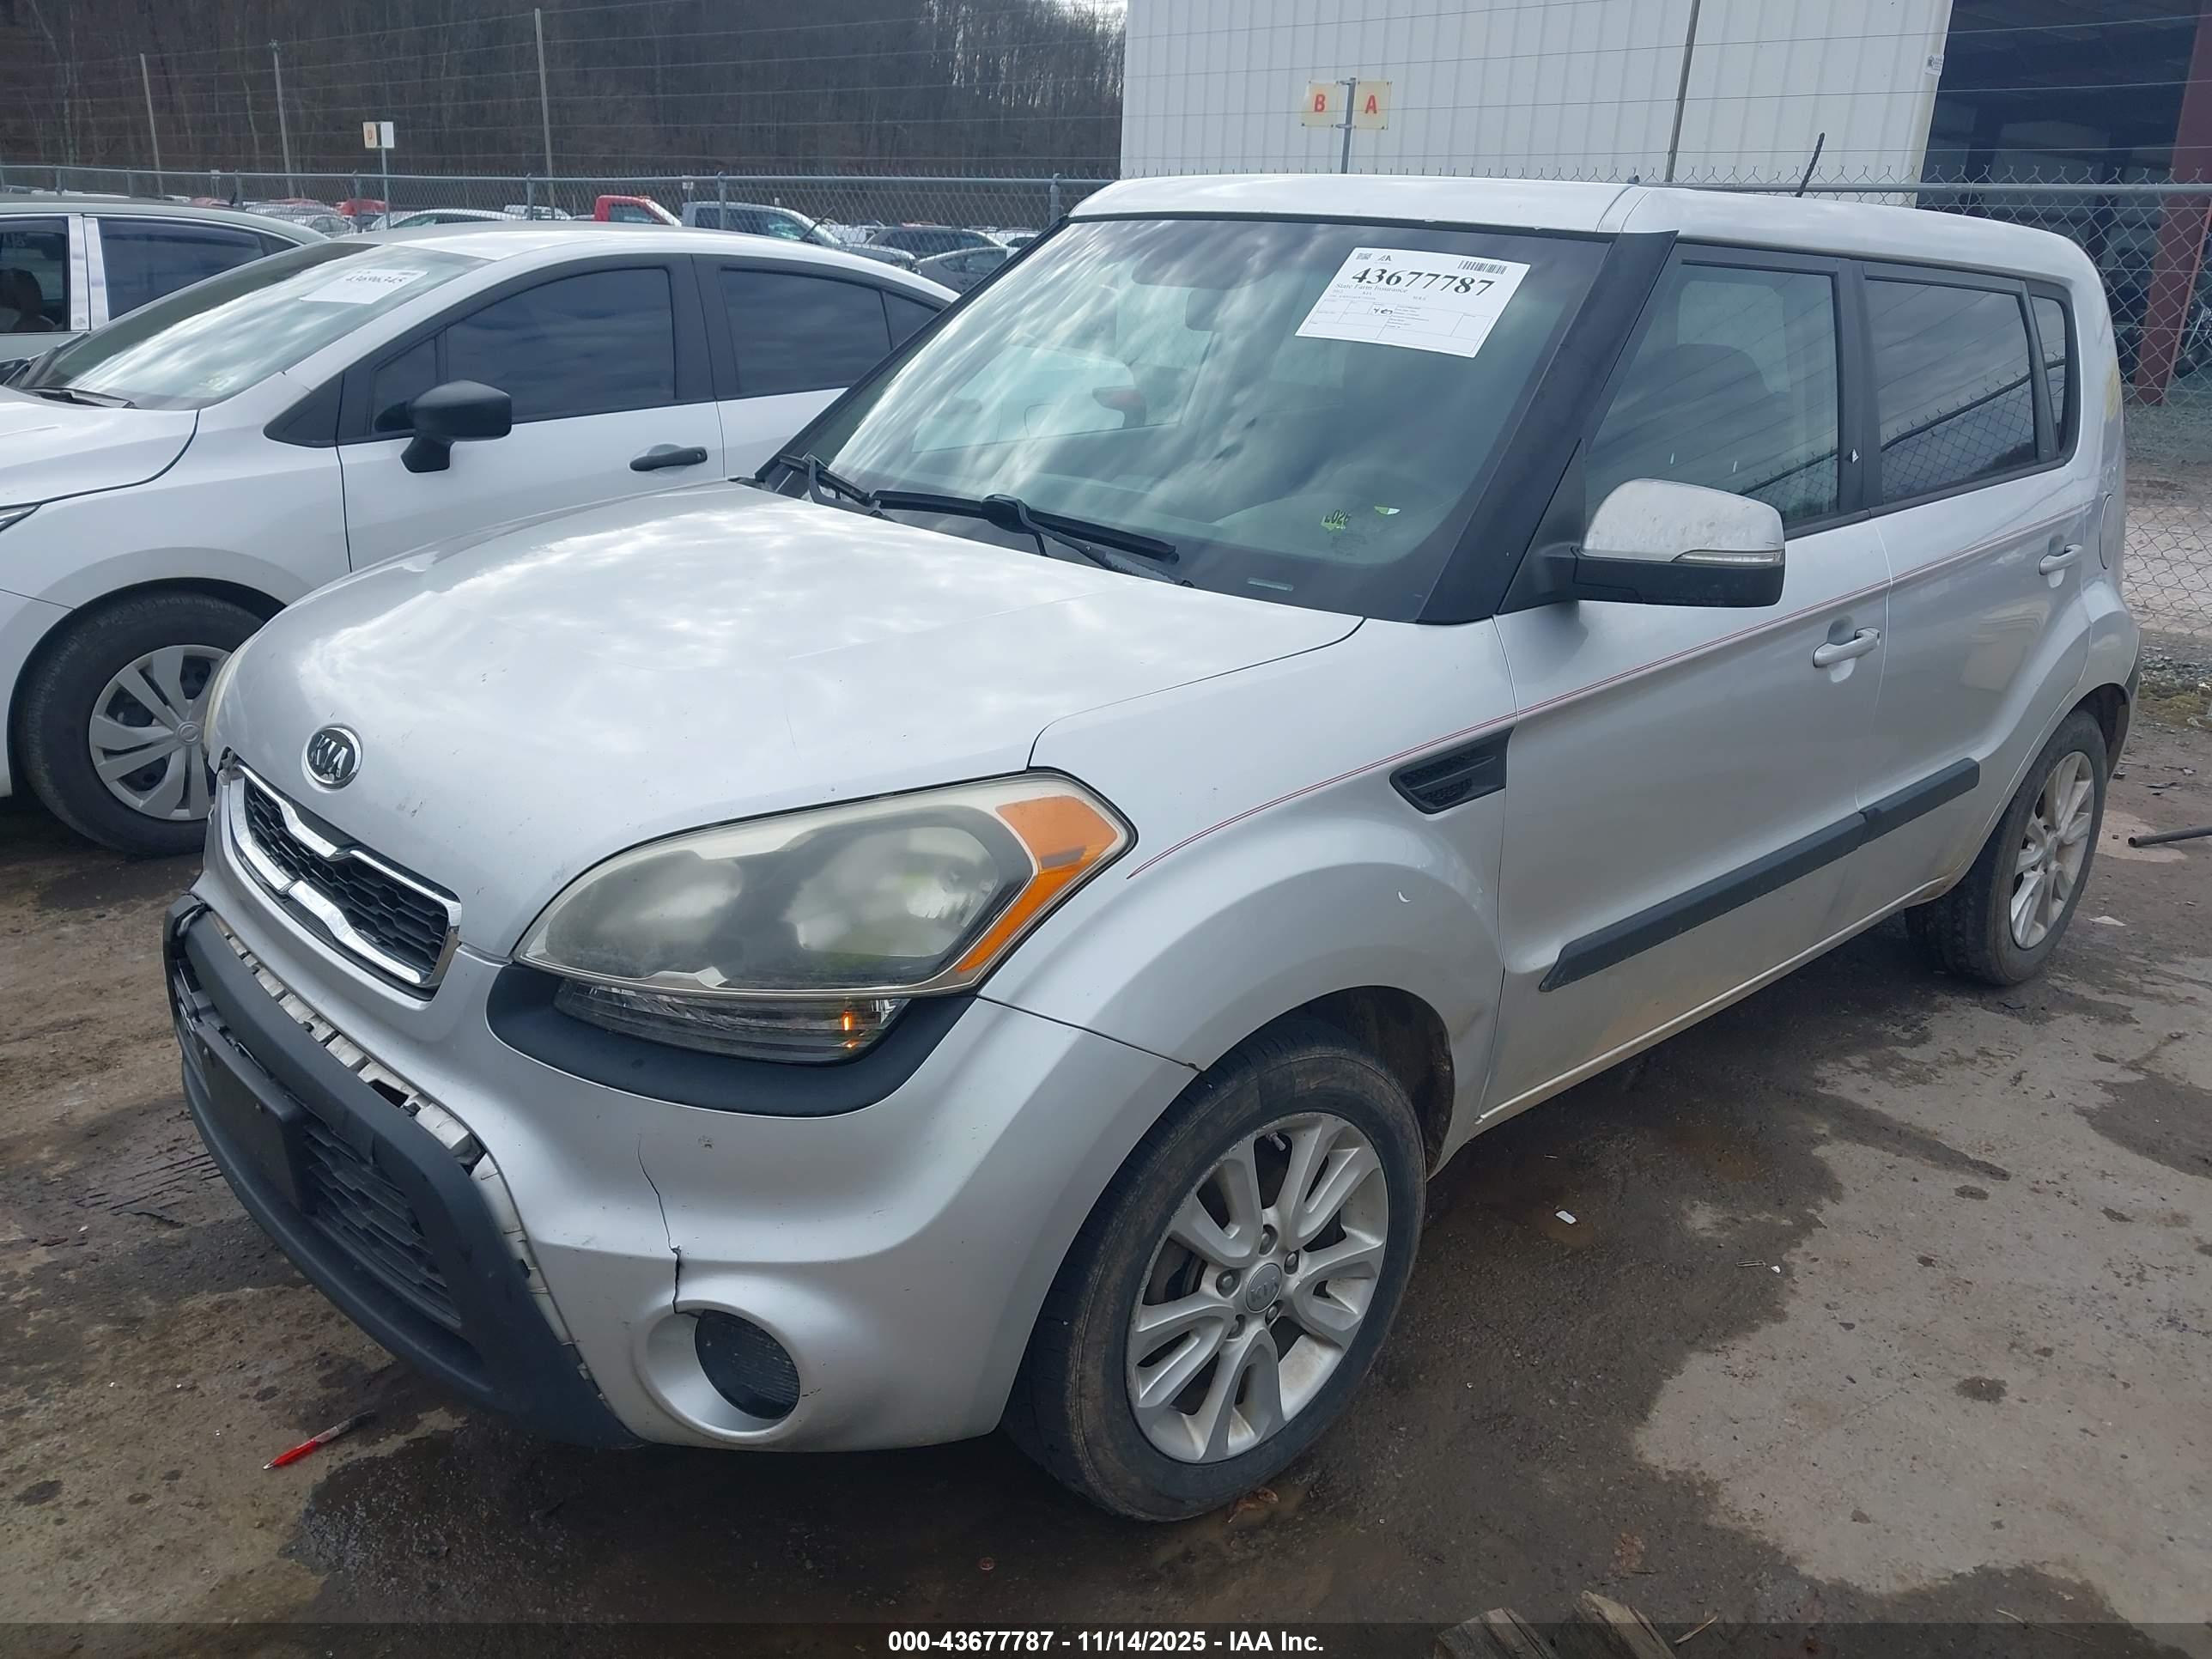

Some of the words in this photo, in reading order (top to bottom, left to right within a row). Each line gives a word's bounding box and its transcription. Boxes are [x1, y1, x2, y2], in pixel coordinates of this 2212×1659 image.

[1314, 94, 1326, 112] B
[1364, 94, 1377, 114] A
[1351, 267, 1496, 296] 43677787
[312, 733, 349, 778] KIA
